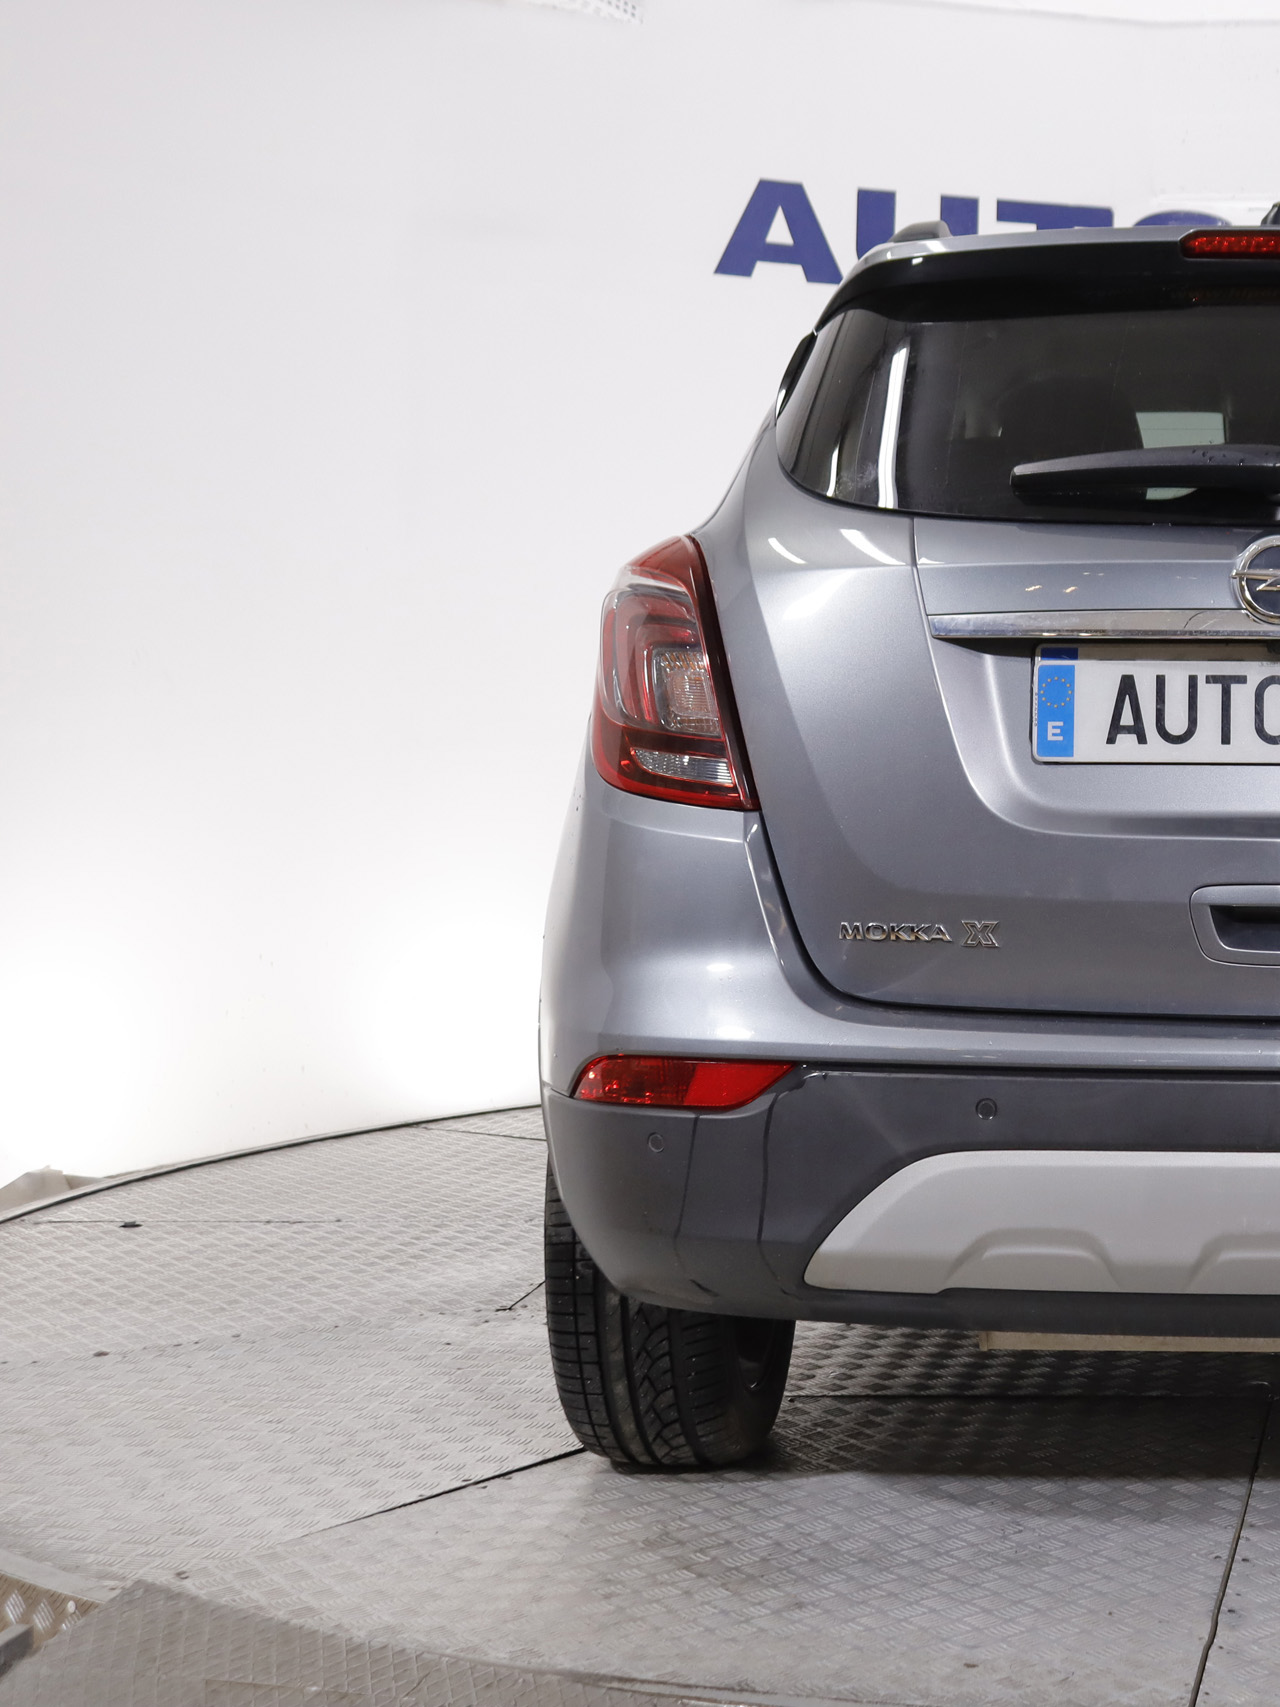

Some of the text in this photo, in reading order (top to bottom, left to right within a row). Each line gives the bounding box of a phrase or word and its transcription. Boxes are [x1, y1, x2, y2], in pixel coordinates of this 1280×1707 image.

[1047, 721, 1064, 741] E
[838, 919, 1000, 948] MOKKA X
